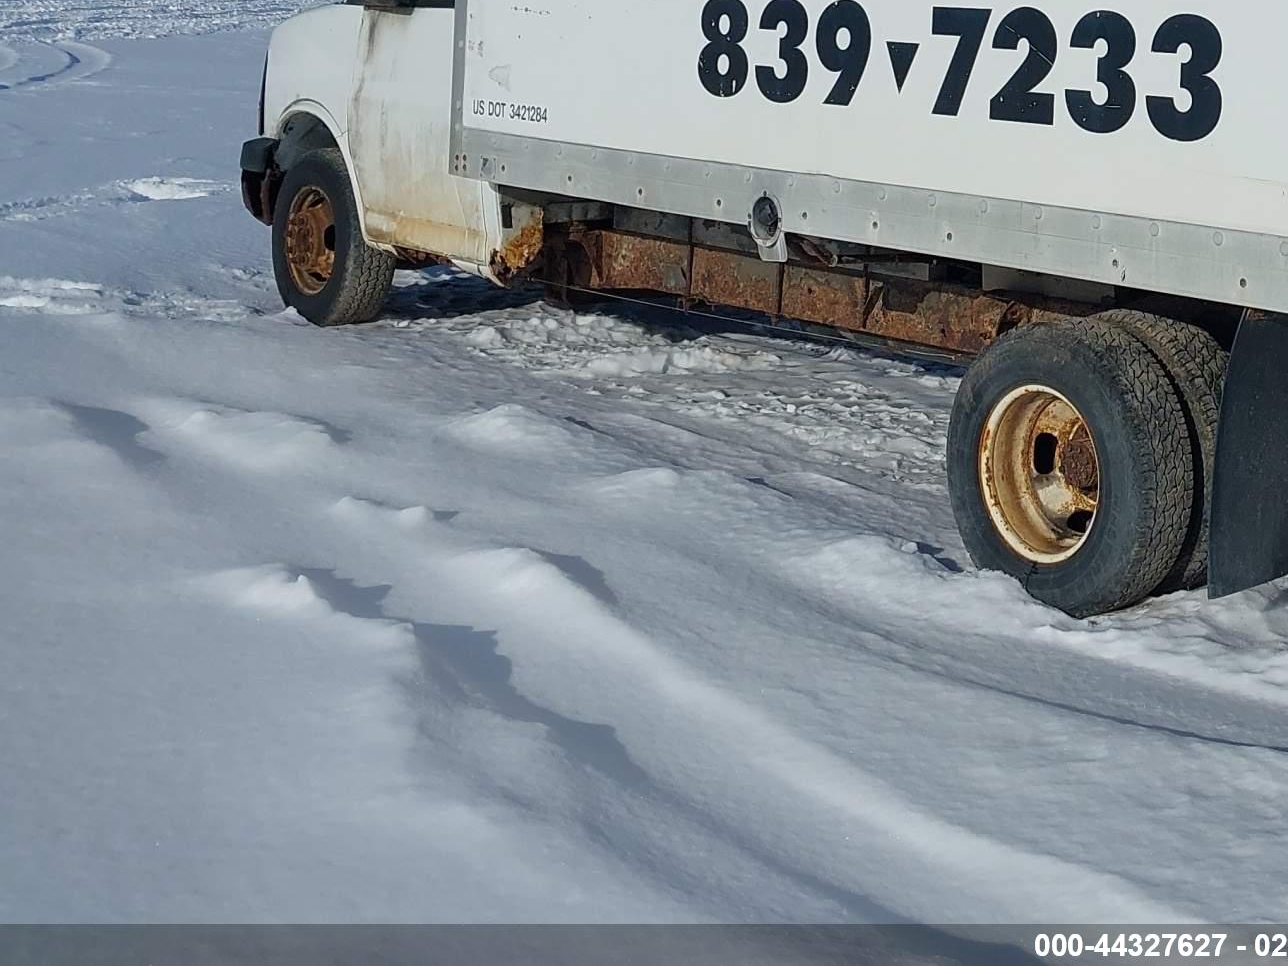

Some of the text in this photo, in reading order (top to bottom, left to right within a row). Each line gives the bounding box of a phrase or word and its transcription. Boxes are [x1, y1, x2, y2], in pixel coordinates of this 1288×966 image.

[472, 99, 548, 123] US DOT 3421284
